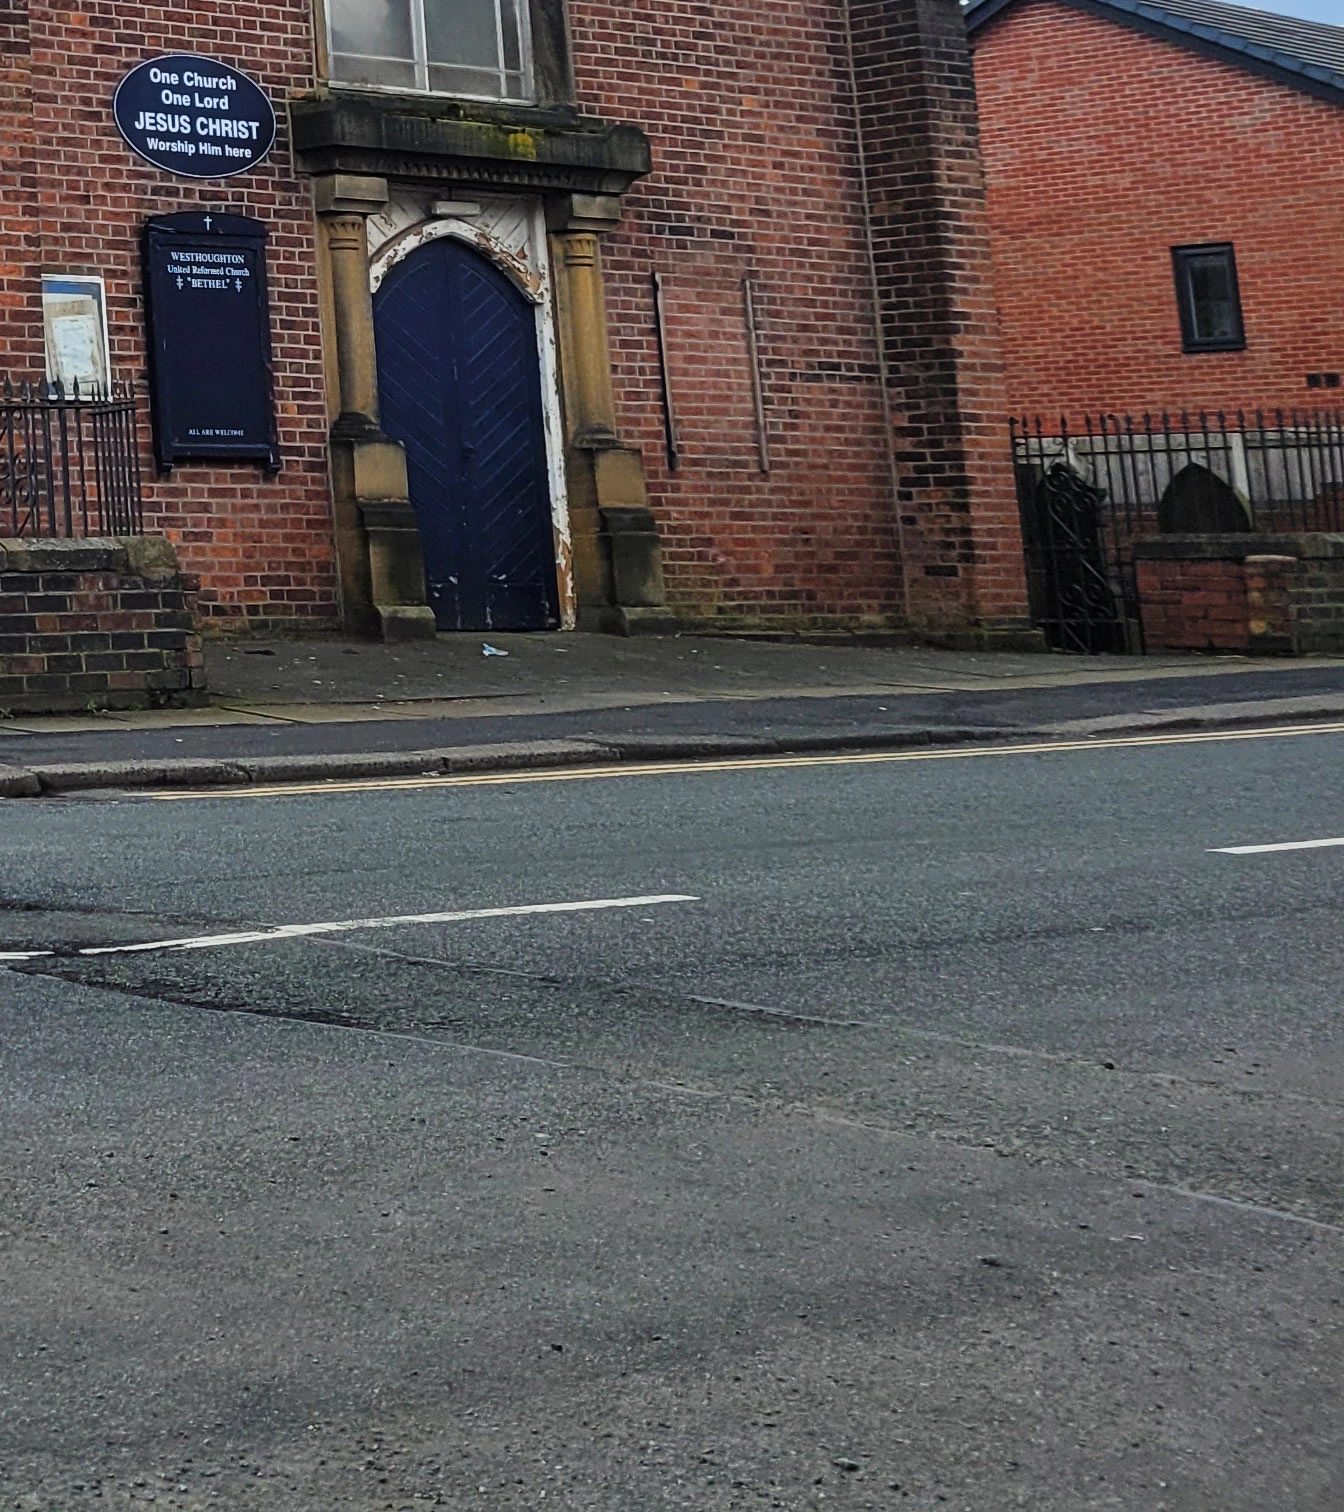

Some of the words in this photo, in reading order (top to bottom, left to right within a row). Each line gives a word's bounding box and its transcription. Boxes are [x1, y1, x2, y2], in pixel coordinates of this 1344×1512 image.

[149, 67, 179, 85] One
[183, 71, 237, 91] Church
[161, 89, 191, 107] One
[194, 92, 229, 110] Lord
[134, 111, 191, 134] JESUS
[195, 116, 260, 140] CHRIST
[146, 137, 195, 156] Worship
[199, 141, 222, 156] Him
[225, 144, 252, 158] here
[170, 251, 245, 264] WESTHOUGHTON
[167, 264, 191, 274] United
[192, 265, 224, 276] Reformed
[225, 267, 250, 277] Church
[188, 428, 200, 436] ALL
